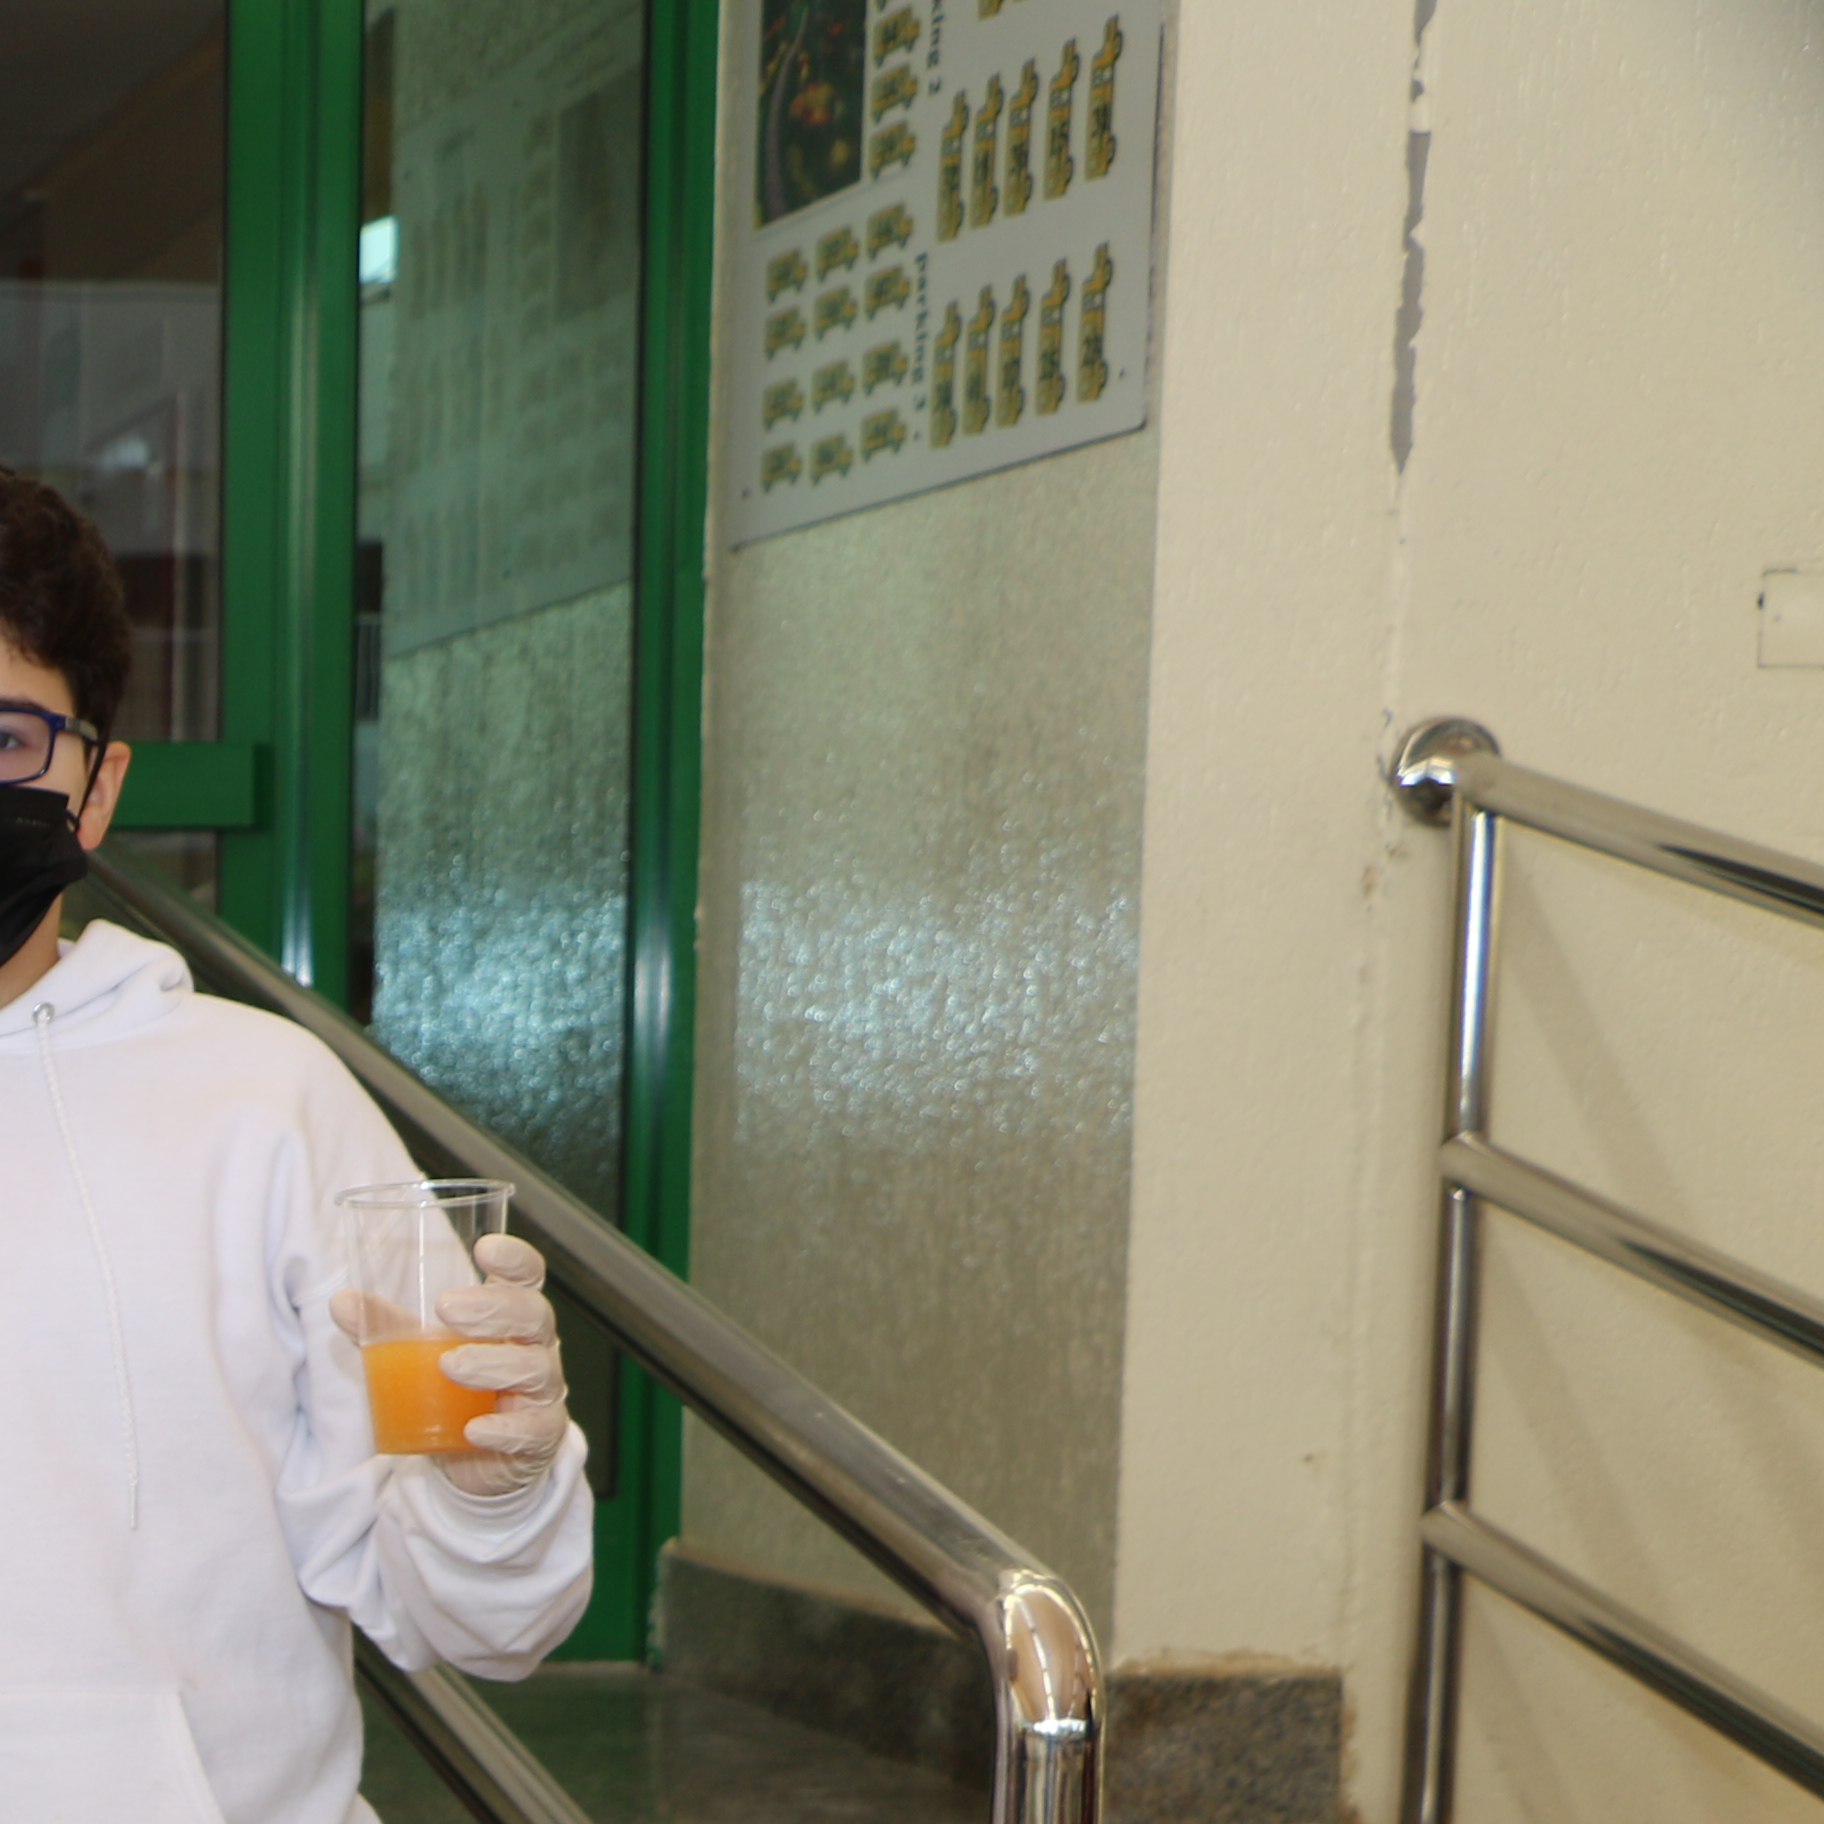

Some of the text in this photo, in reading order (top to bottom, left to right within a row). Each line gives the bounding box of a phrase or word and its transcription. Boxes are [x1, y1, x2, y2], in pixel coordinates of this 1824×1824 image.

[928, 75, 943, 95] 2
[912, 252, 929, 411] parking 3
